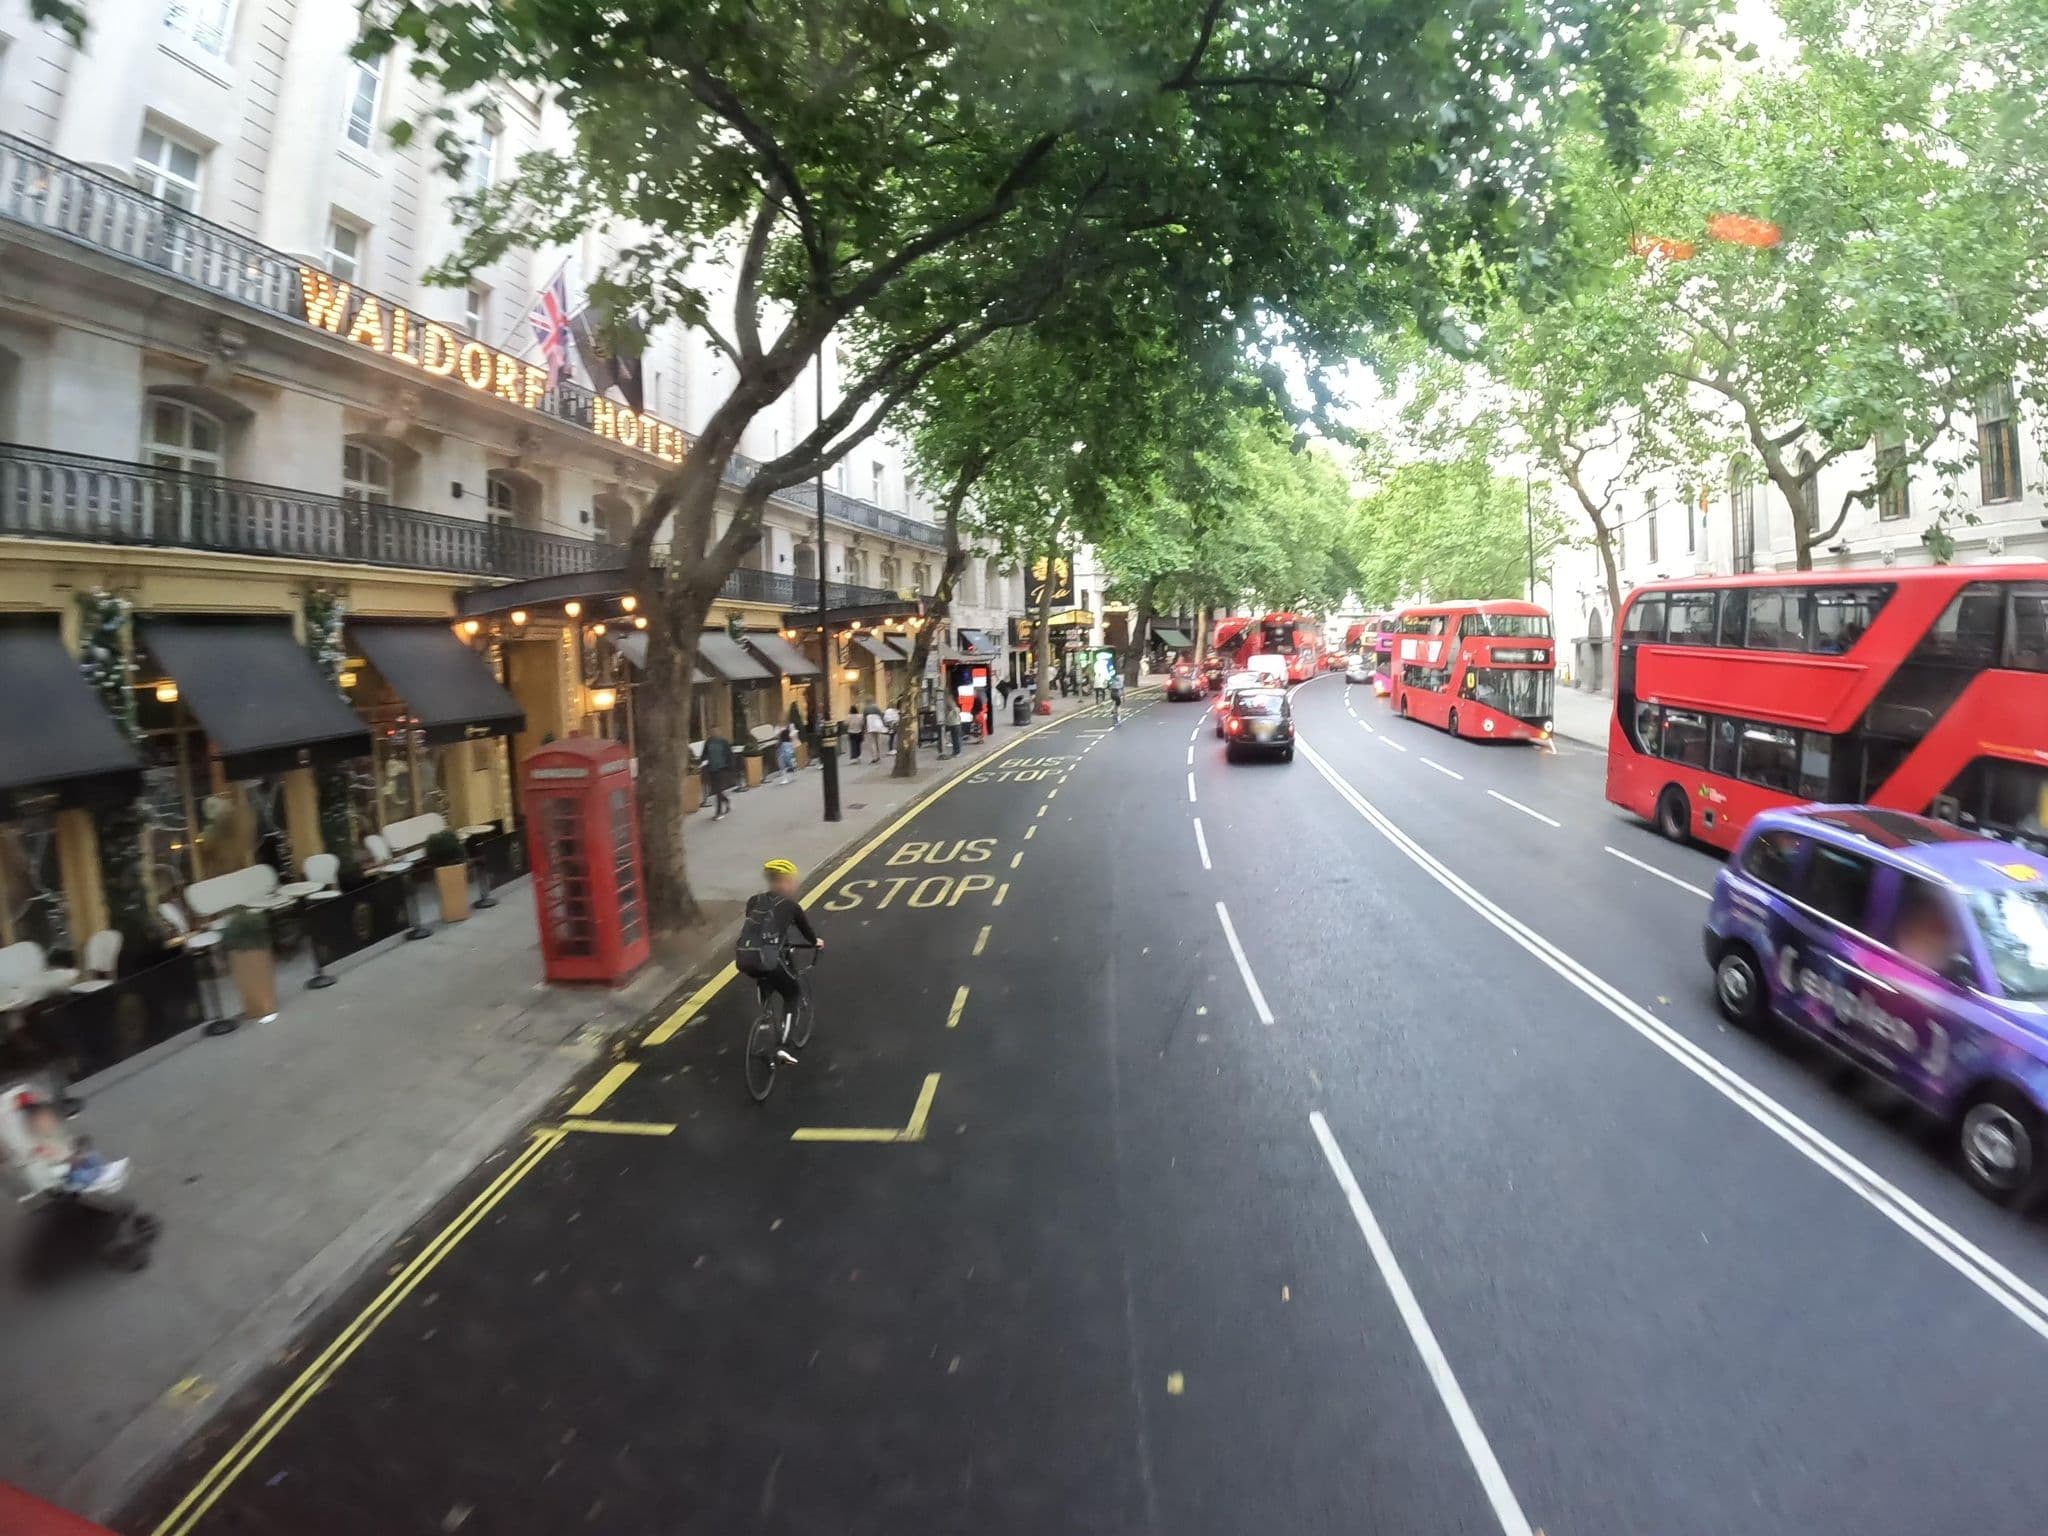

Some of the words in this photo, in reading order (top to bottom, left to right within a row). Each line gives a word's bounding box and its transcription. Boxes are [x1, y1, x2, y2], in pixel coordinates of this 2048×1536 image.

[299, 267, 548, 409] WALDORF
[592, 395, 684, 464] HOTEL
[1532, 650, 1545, 662] 76
[998, 756, 1065, 769] BUS
[967, 768, 1064, 784] STOP
[885, 838, 998, 866] BUS
[823, 874, 996, 911] STOP
